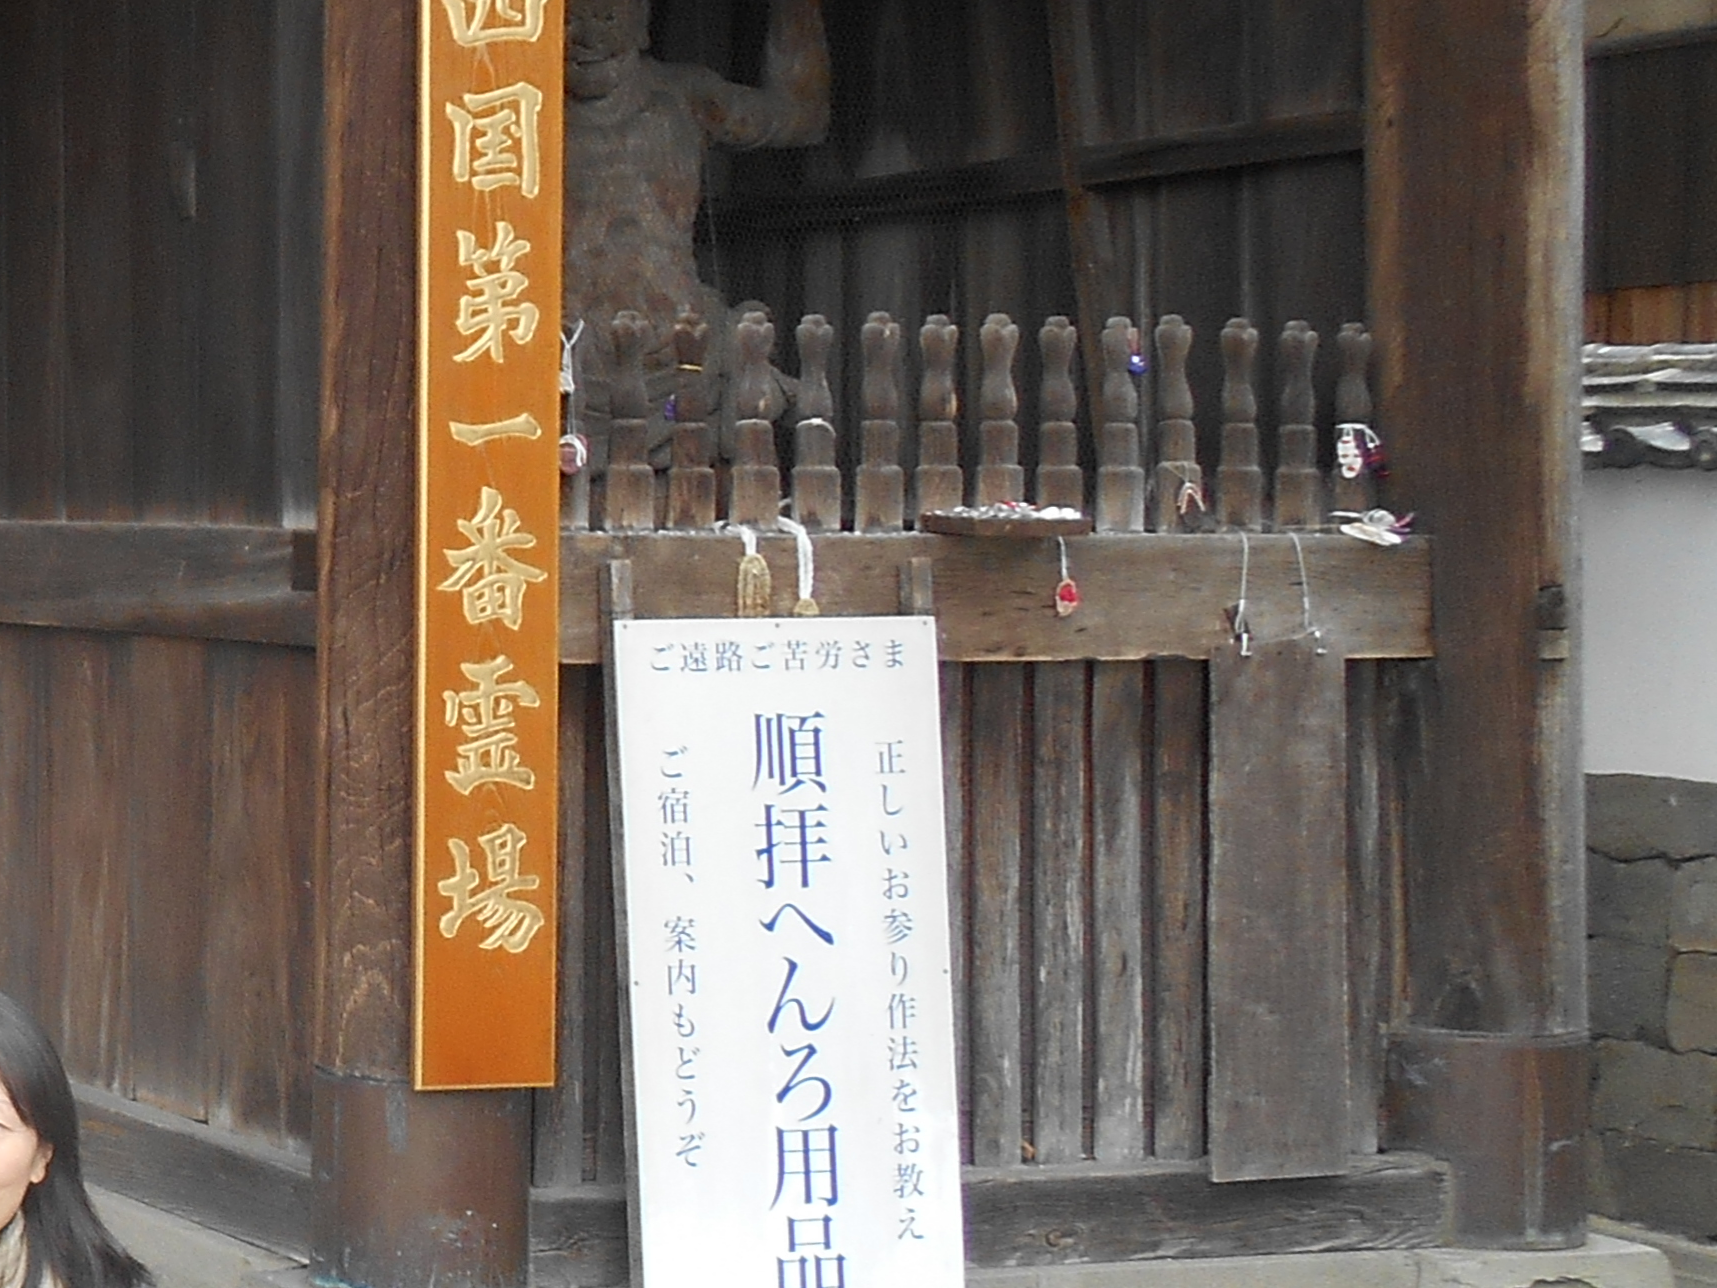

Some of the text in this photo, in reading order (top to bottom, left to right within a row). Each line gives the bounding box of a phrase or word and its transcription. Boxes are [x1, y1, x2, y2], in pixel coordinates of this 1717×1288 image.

[649, 638, 906, 674] ご遠路ご苦労さま
[874, 739, 925, 1242] 正しいお参り作法をお教え
